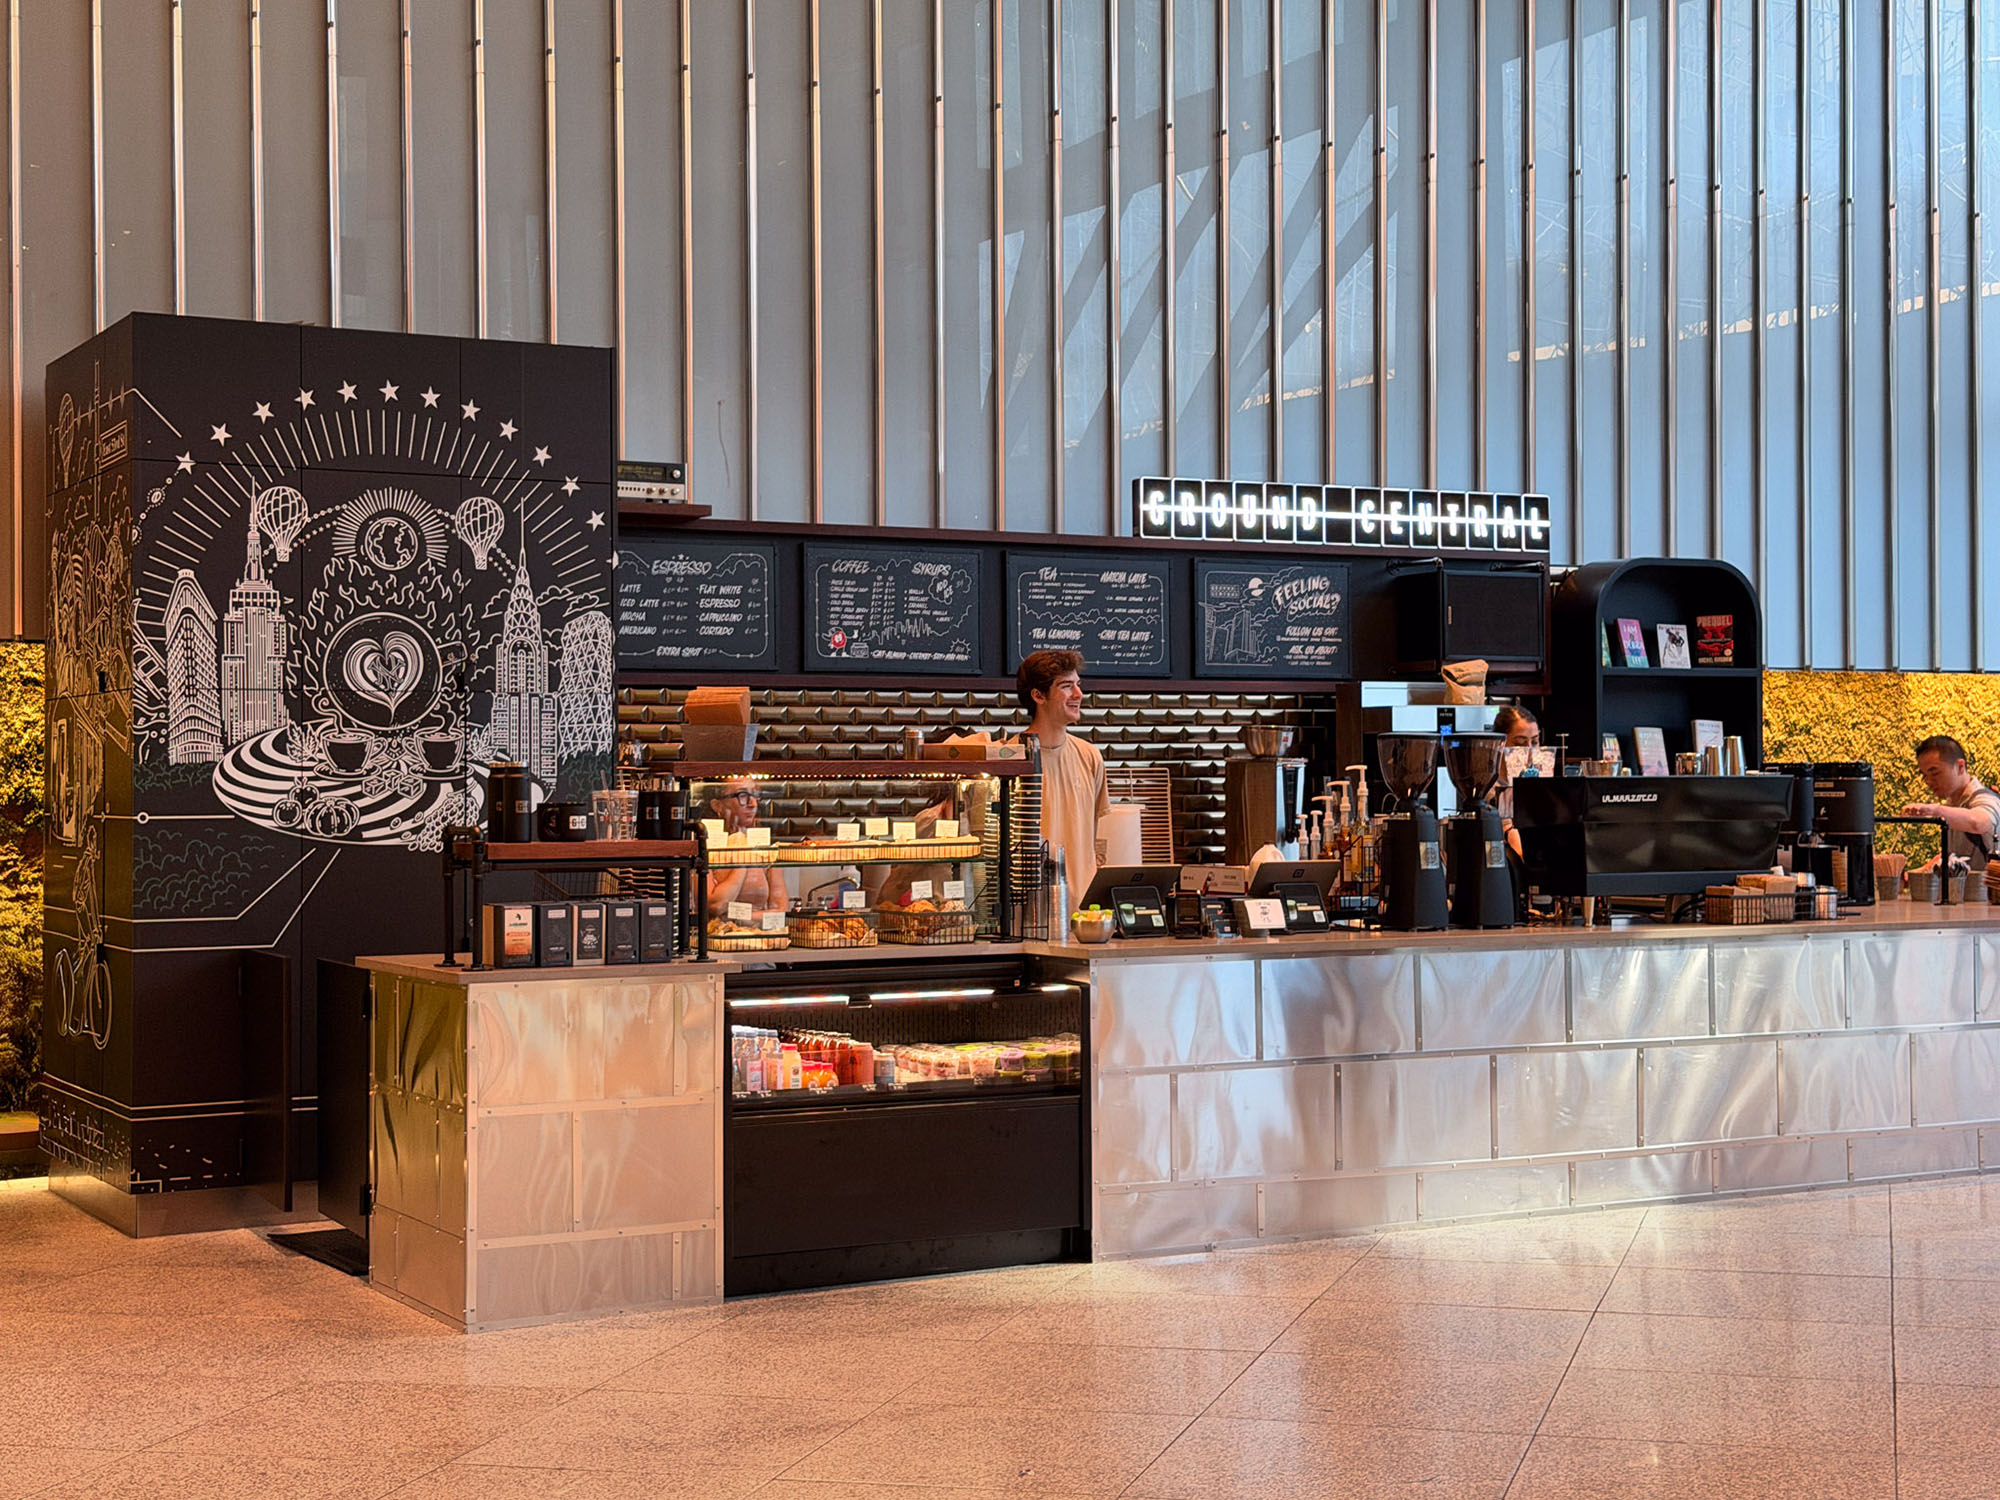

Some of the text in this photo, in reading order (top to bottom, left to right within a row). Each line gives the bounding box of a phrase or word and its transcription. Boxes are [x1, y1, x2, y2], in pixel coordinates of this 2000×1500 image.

[1148, 490, 1543, 540] GROUND CENTRAL
[651, 559, 712, 576] ESPRESSO
[832, 559, 870, 574] COFFEE
[911, 562, 952, 576] SYRUPS
[1038, 566, 1058, 581] TEA
[1100, 571, 1148, 585] MATCHA LATTE
[619, 584, 642, 593] LATTE
[699, 584, 743, 595] FLAT WHITE
[1275, 576, 1331, 606] FEELING
[619, 598, 659, 608] ICED LATTE
[699, 598, 741, 608] ESPRESSO
[1288, 593, 1341, 615] SOCIAL?
[619, 611, 646, 622] MOCHA
[699, 612, 743, 622] CAPPUCCINO
[619, 625, 657, 635] AMERICANO
[699, 625, 735, 636] CORTADO
[1032, 628, 1081, 640] TEA LEMONADE
[1117, 630, 1130, 641] TEA
[1131, 631, 1151, 642] LATTE
[1285, 626, 1311, 637] FOLLOW
[1312, 627, 1323, 637] US
[656, 646, 680, 657] EXTRA
[681, 647, 703, 658] SHOT
[1289, 645, 1303, 655] ASK
[1305, 645, 1314, 655] US
